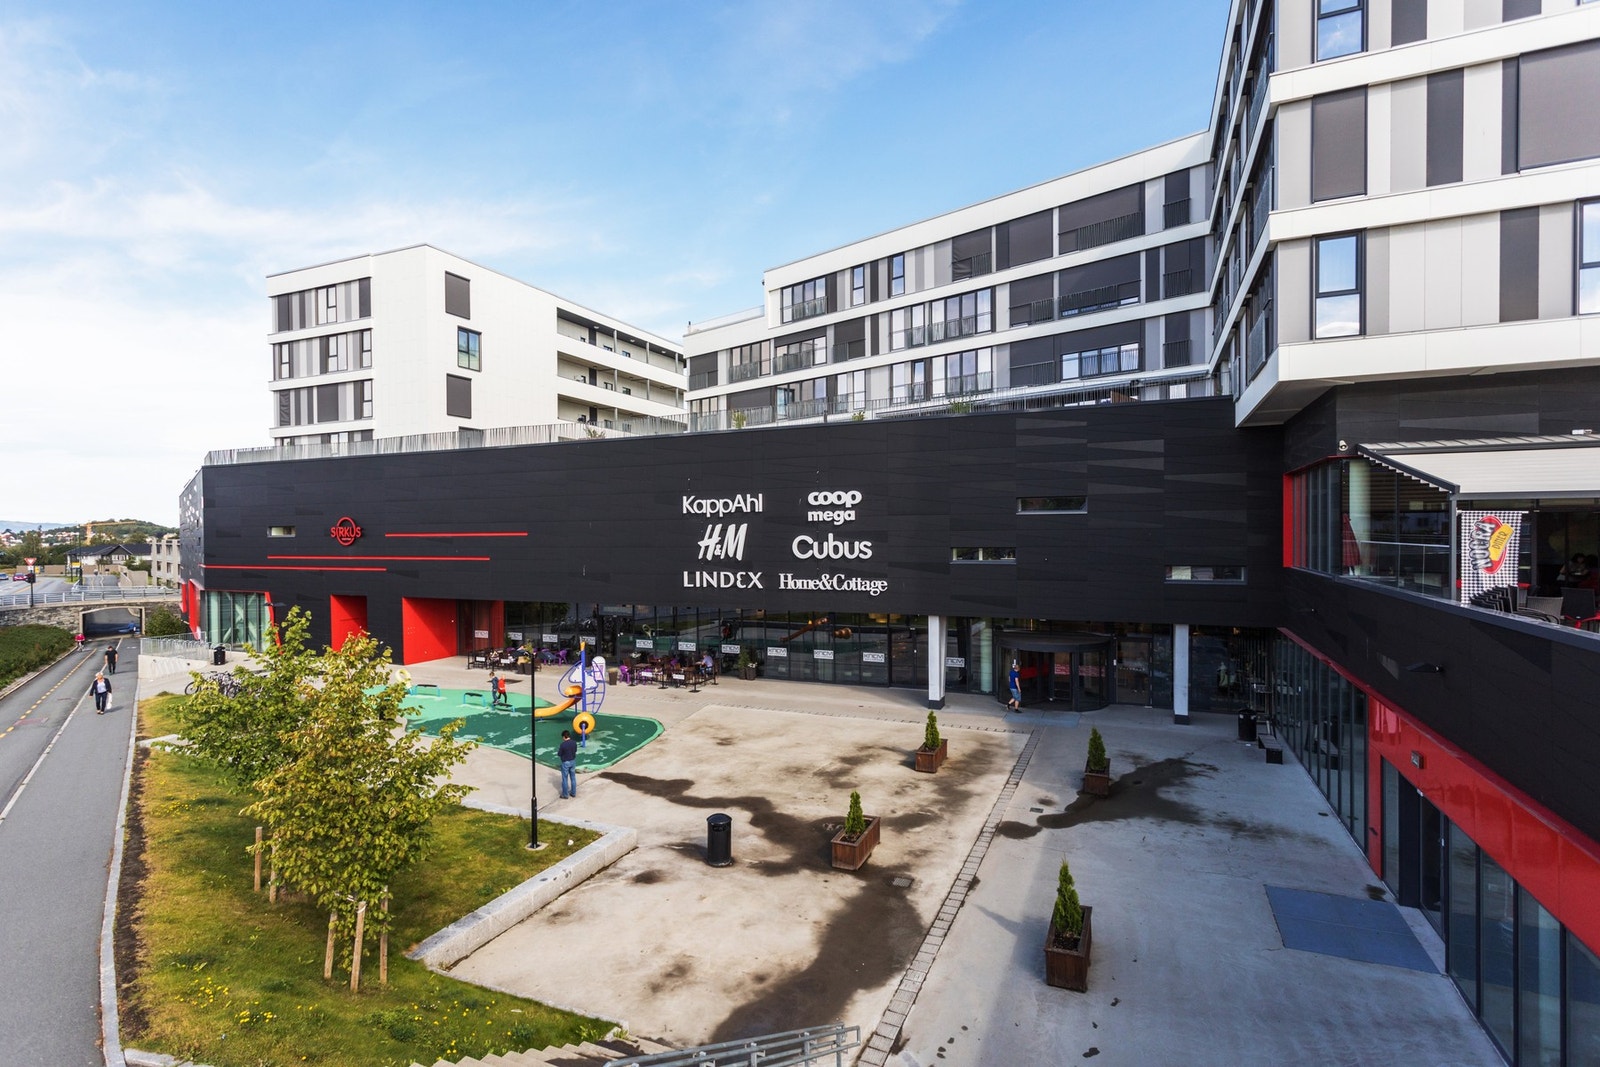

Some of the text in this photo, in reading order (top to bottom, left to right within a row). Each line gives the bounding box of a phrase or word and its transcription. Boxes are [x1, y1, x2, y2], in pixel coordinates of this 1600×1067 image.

[682, 493, 763, 518] KappAhl
[807, 490, 862, 508] coop
[807, 509, 856, 526] mega
[330, 526, 362, 538] SIRKUS
[697, 523, 748, 561] H&M
[792, 532, 873, 560] Cubus
[683, 570, 764, 589] LINDEX
[778, 573, 888, 596] Home&Cottage
